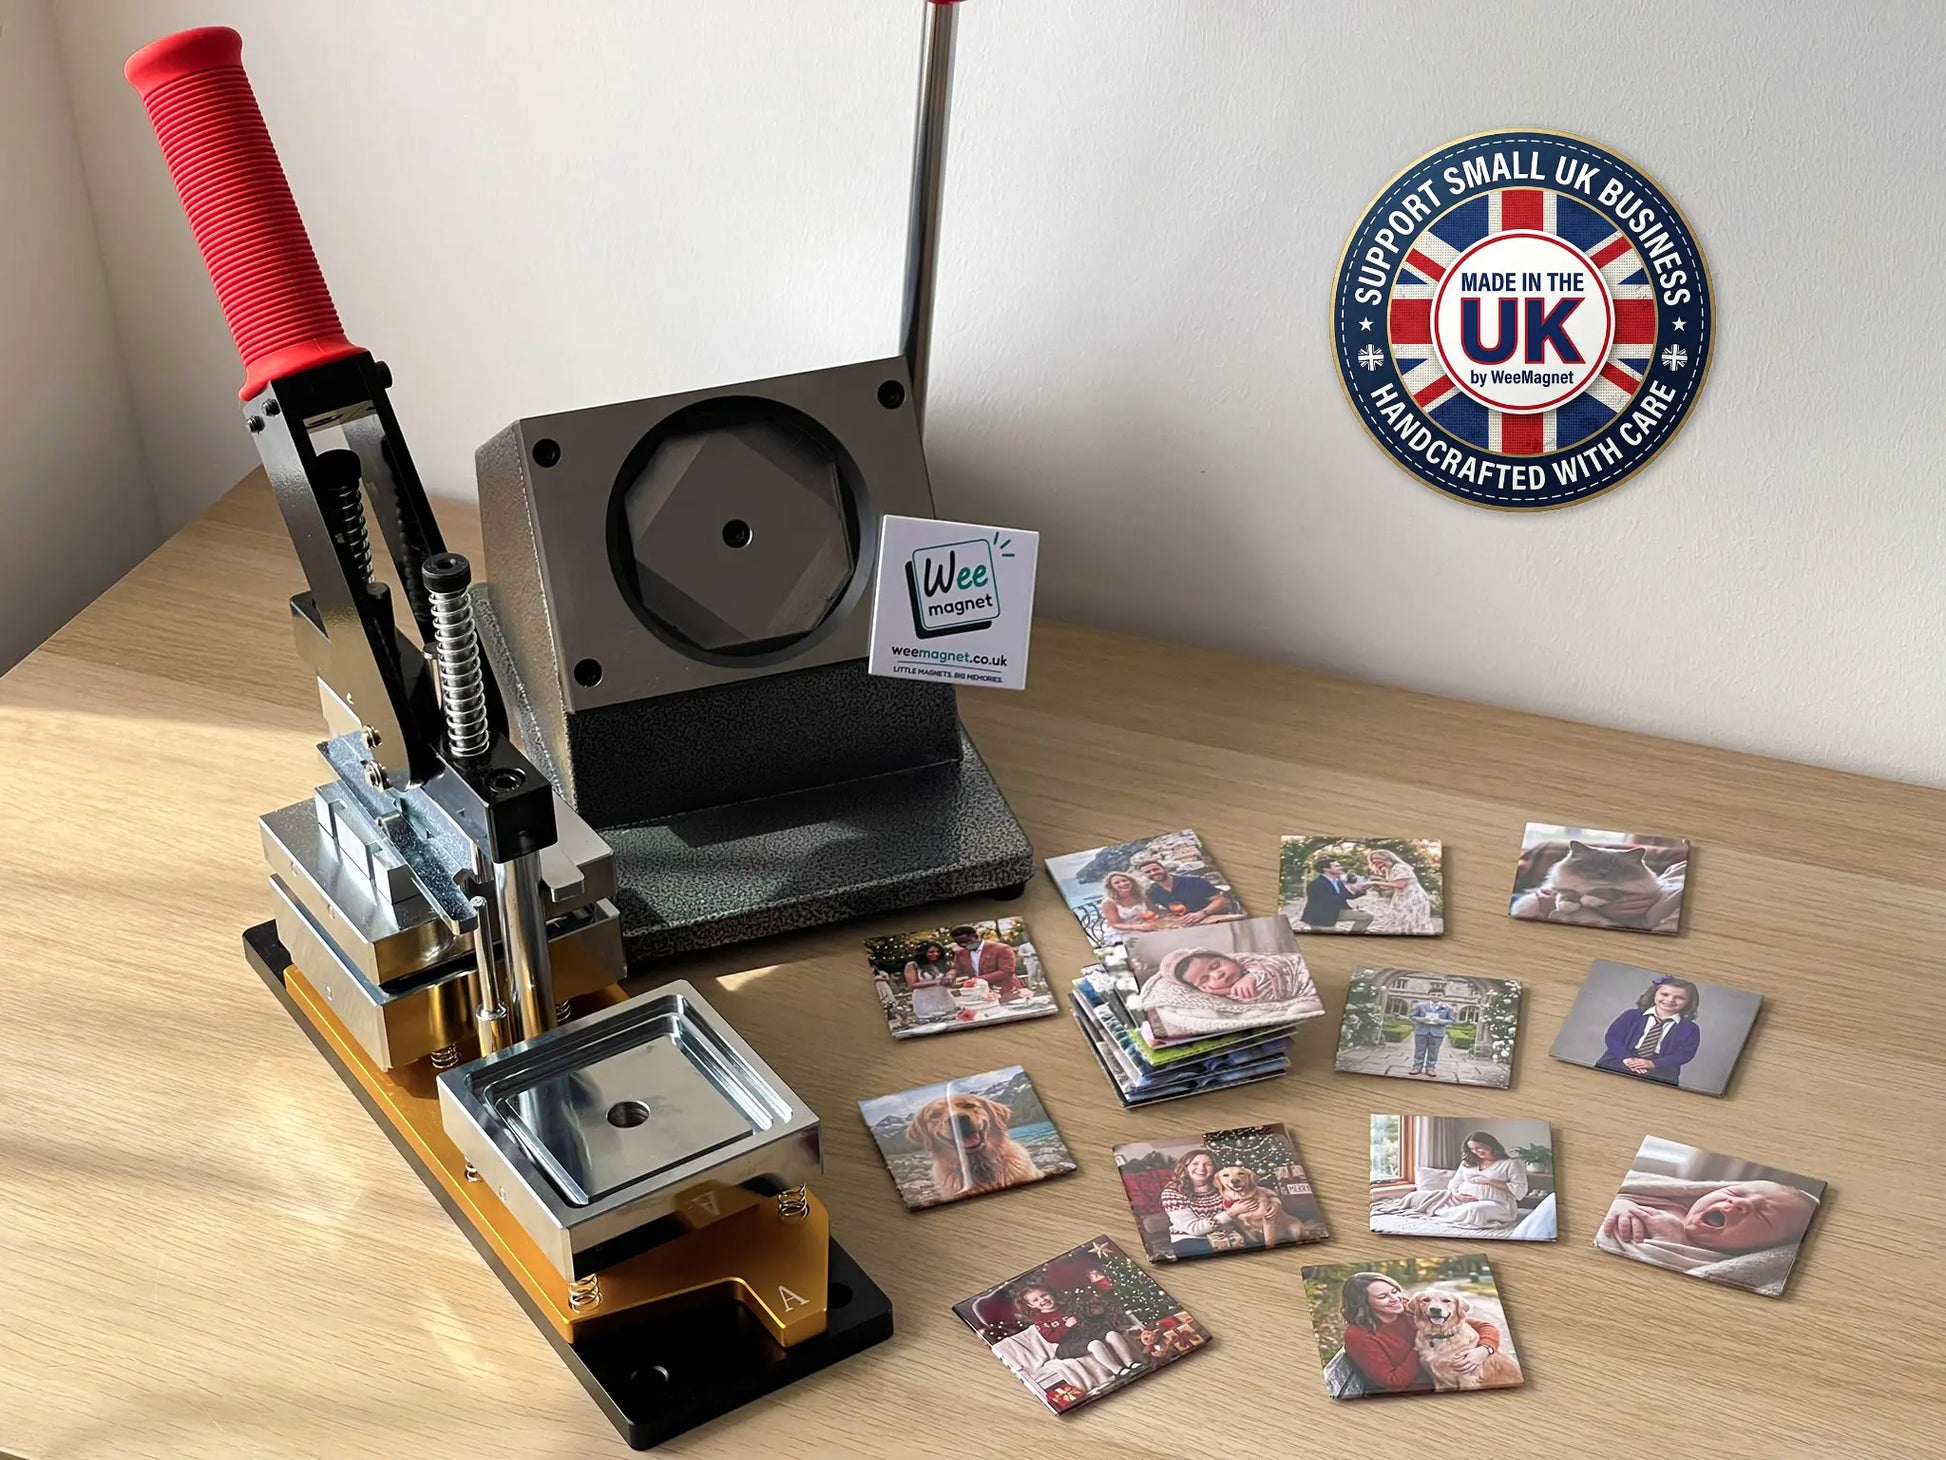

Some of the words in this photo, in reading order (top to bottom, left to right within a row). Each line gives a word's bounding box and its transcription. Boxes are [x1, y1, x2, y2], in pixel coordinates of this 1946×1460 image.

[923, 550, 988, 598] Wee
[928, 593, 993, 616] magnet
[891, 646, 1008, 667] weemagnet.co.uk
[893, 665, 917, 675] LITTLE
[954, 672, 966, 680] BIG
[777, 1284, 810, 1312] A
